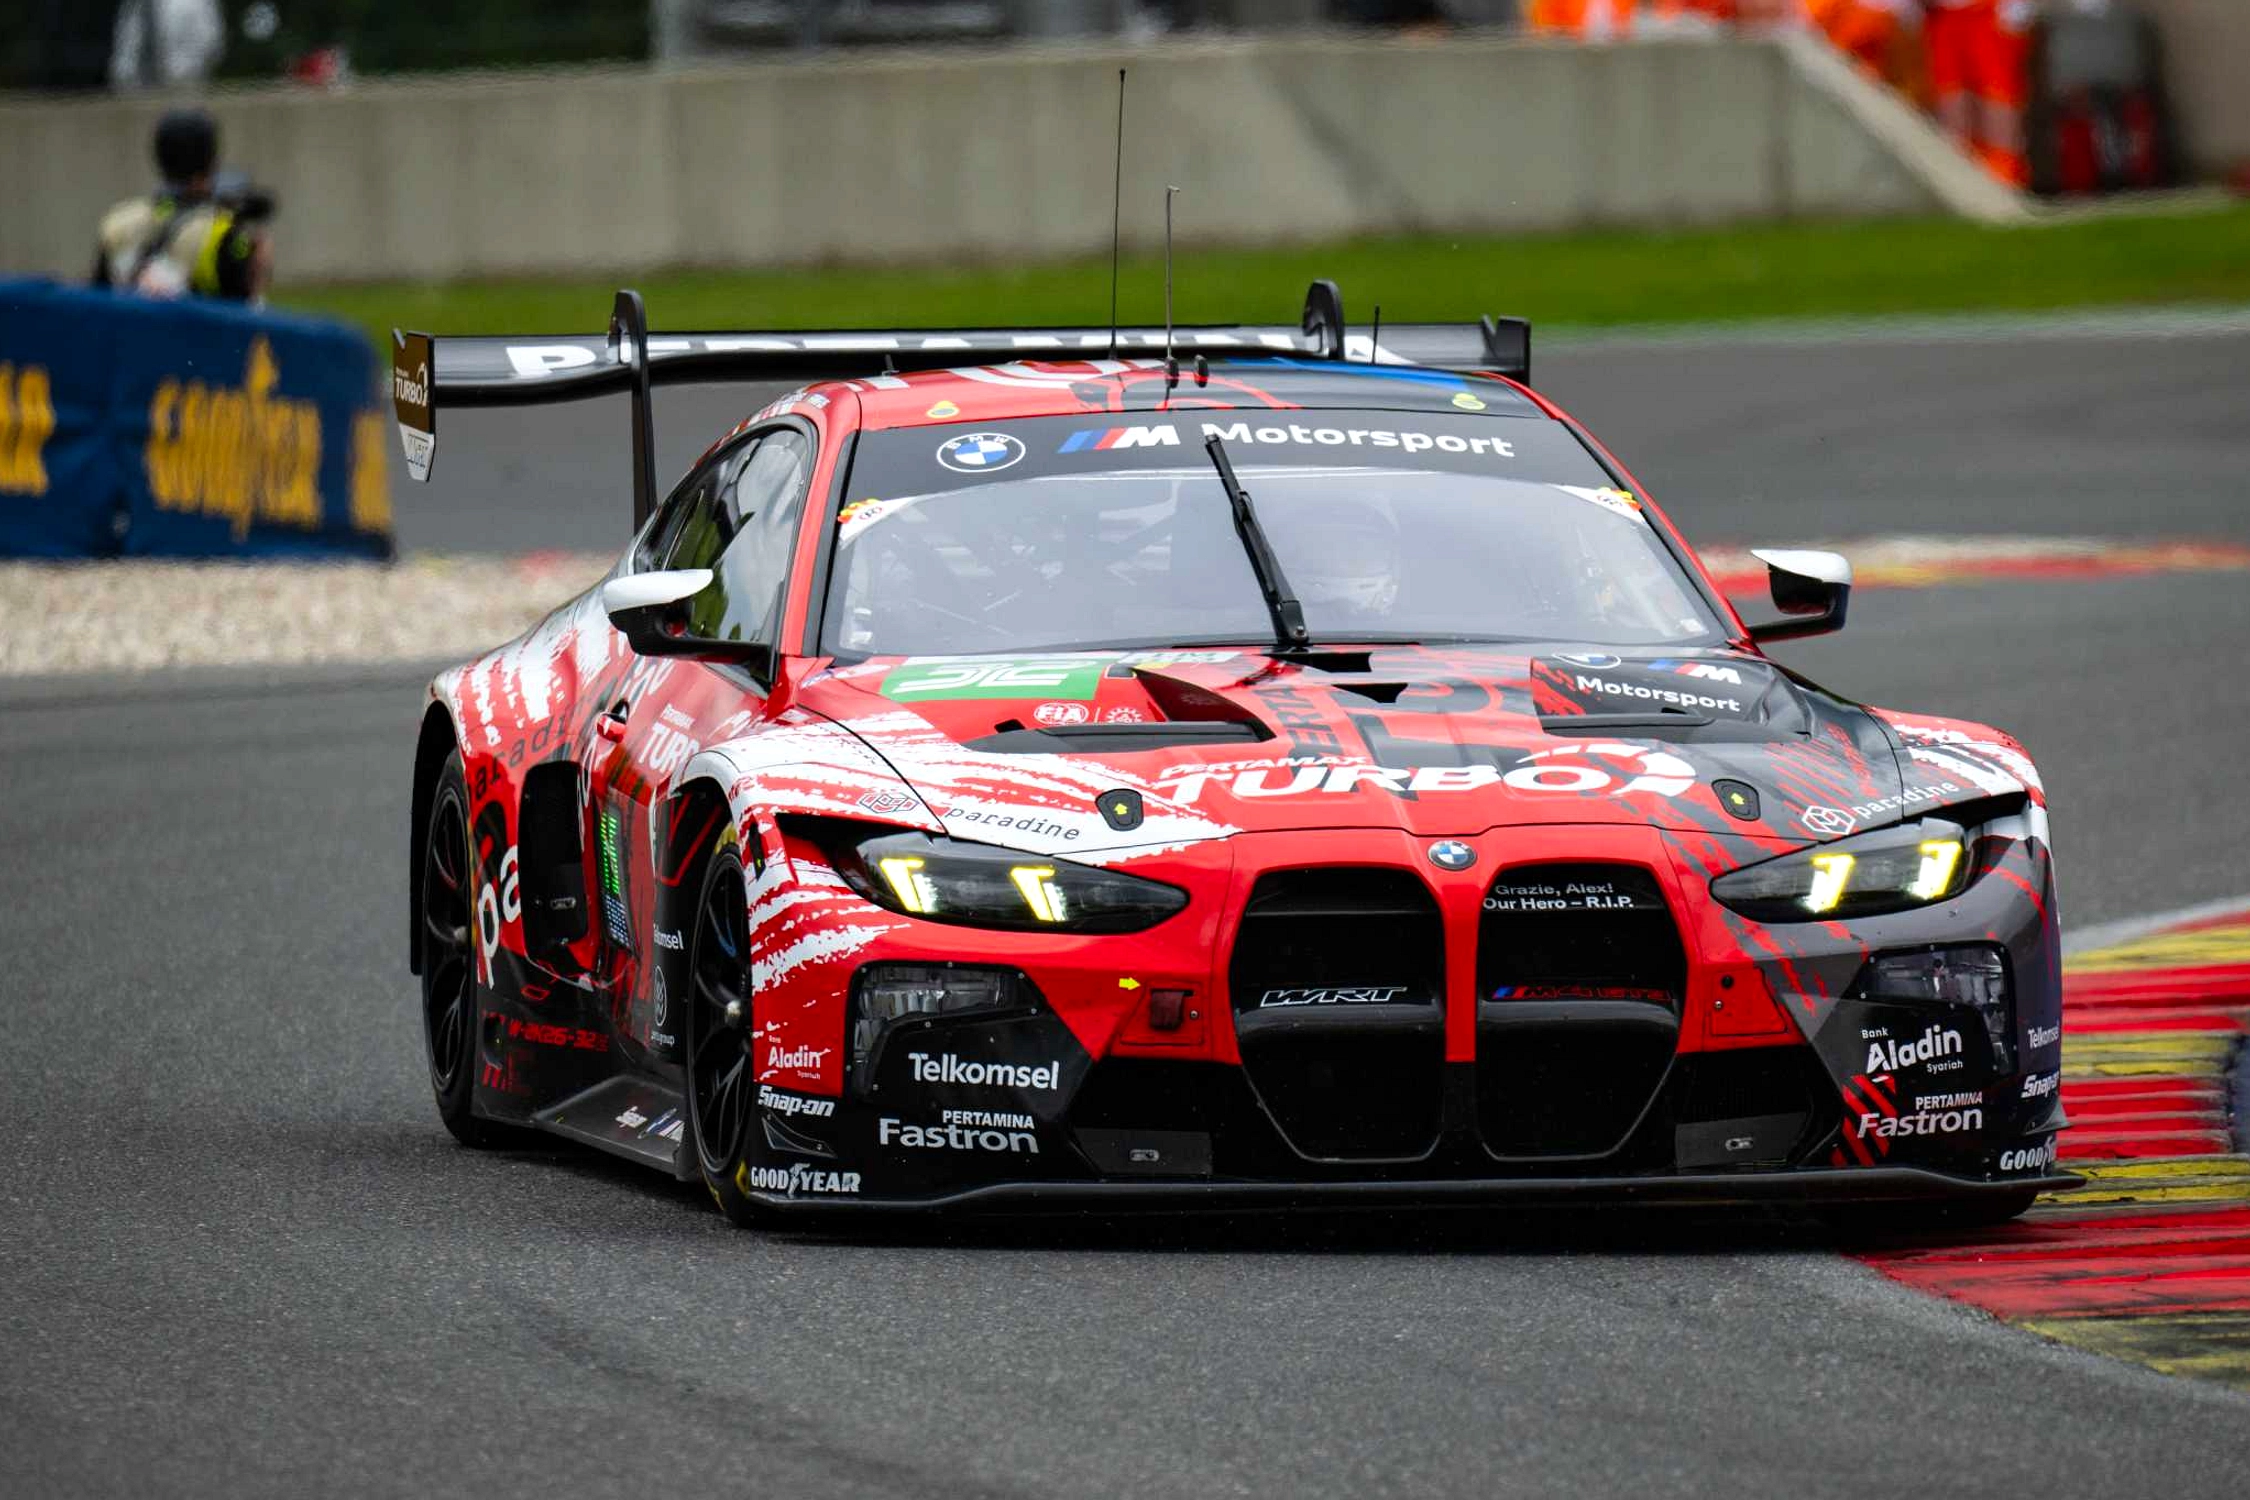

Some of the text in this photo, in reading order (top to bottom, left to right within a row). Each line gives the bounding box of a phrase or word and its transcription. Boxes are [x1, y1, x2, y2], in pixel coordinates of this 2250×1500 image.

[1201, 422, 1516, 457] Motorsport
[1576, 675, 1741, 712] Motorsport
[1149, 763, 1613, 802] TURBO
[1160, 756, 1367, 779] PERTAMAX
[1852, 779, 1961, 820] paradine
[946, 805, 1081, 841] paradine
[1483, 898, 1517, 910] Our
[1520, 898, 1567, 910] Hero
[1586, 896, 1635, 908] R.I.P.
[1495, 882, 1614, 897] Grazie, Alex!
[1260, 986, 1408, 1007] WRT
[1861, 1026, 1889, 1039] Bank
[768, 1044, 821, 1069] Aladin
[1866, 1024, 1963, 1075] Aladin
[908, 1052, 1060, 1091] Telkomsel
[1926, 1060, 1964, 1075] Syariah
[758, 1084, 836, 1117] Snap-on
[1915, 1091, 1983, 1110] PERTAMINA
[879, 1117, 1040, 1153] Fastron
[942, 1110, 1035, 1129] PERTAMINA
[1857, 1107, 1983, 1139] Fastron
[751, 1164, 862, 1194] GOODYEAR
